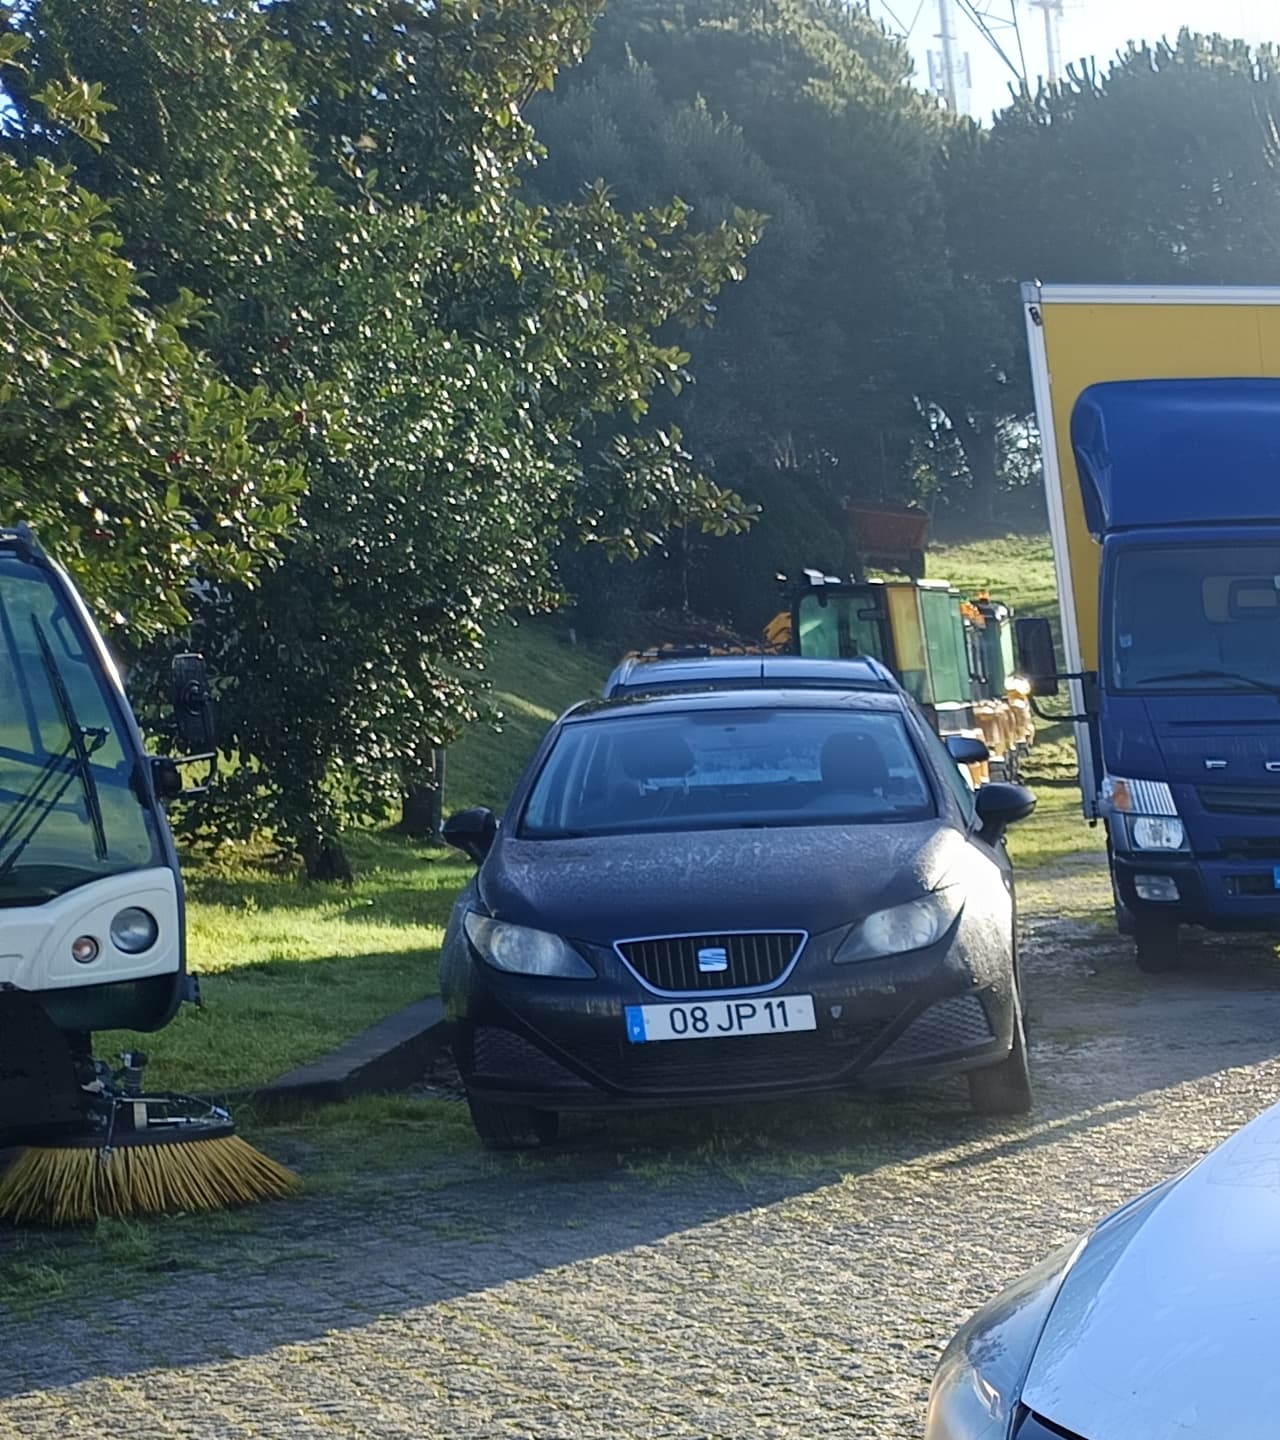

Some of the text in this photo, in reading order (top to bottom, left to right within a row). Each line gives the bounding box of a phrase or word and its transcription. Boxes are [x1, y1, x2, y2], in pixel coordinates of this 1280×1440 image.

[669, 1006, 710, 1035] 08
[716, 1002, 757, 1032] JP
[763, 1000, 789, 1029] 11
